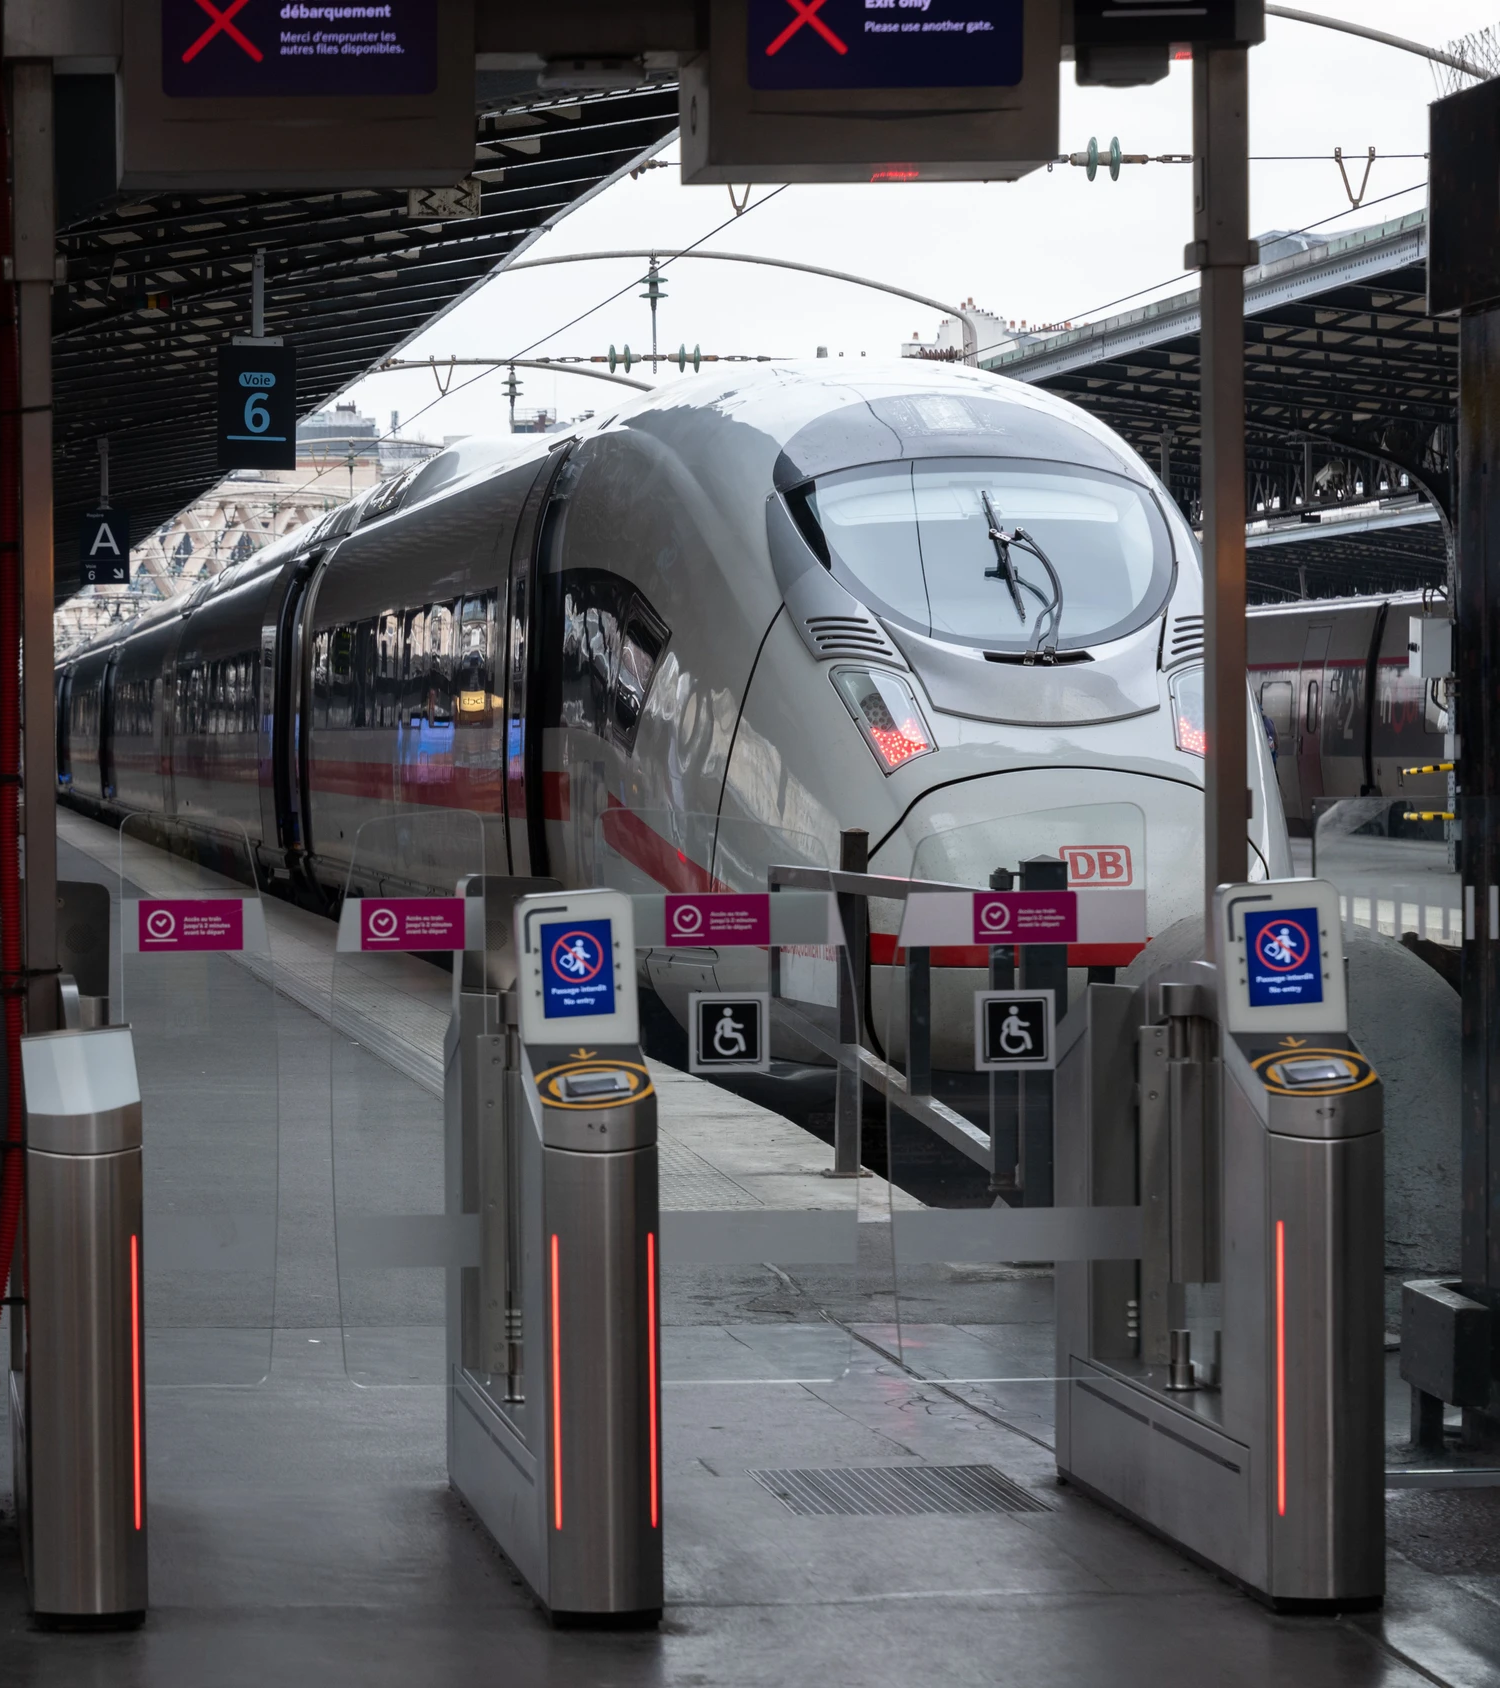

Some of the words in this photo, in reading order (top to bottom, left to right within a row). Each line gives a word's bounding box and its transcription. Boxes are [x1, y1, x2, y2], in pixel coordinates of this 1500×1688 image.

[280, 3, 391, 21] débarquement
[899, 0, 931, 11] only
[864, 21, 900, 32] Please
[901, 22, 921, 32] use
[921, 20, 965, 31] another
[966, 20, 994, 33] gate.
[280, 31, 311, 42] Merci
[312, 31, 379, 43] d'emprunter
[381, 30, 397, 41] les
[280, 45, 314, 55] autres
[316, 43, 339, 54] files
[340, 43, 405, 56] disponibles.
[243, 374, 271, 386] Voie
[244, 392, 271, 433] 6
[89, 523, 121, 555] A
[88, 570, 96, 581] 6
[1068, 851, 1124, 880] DB
